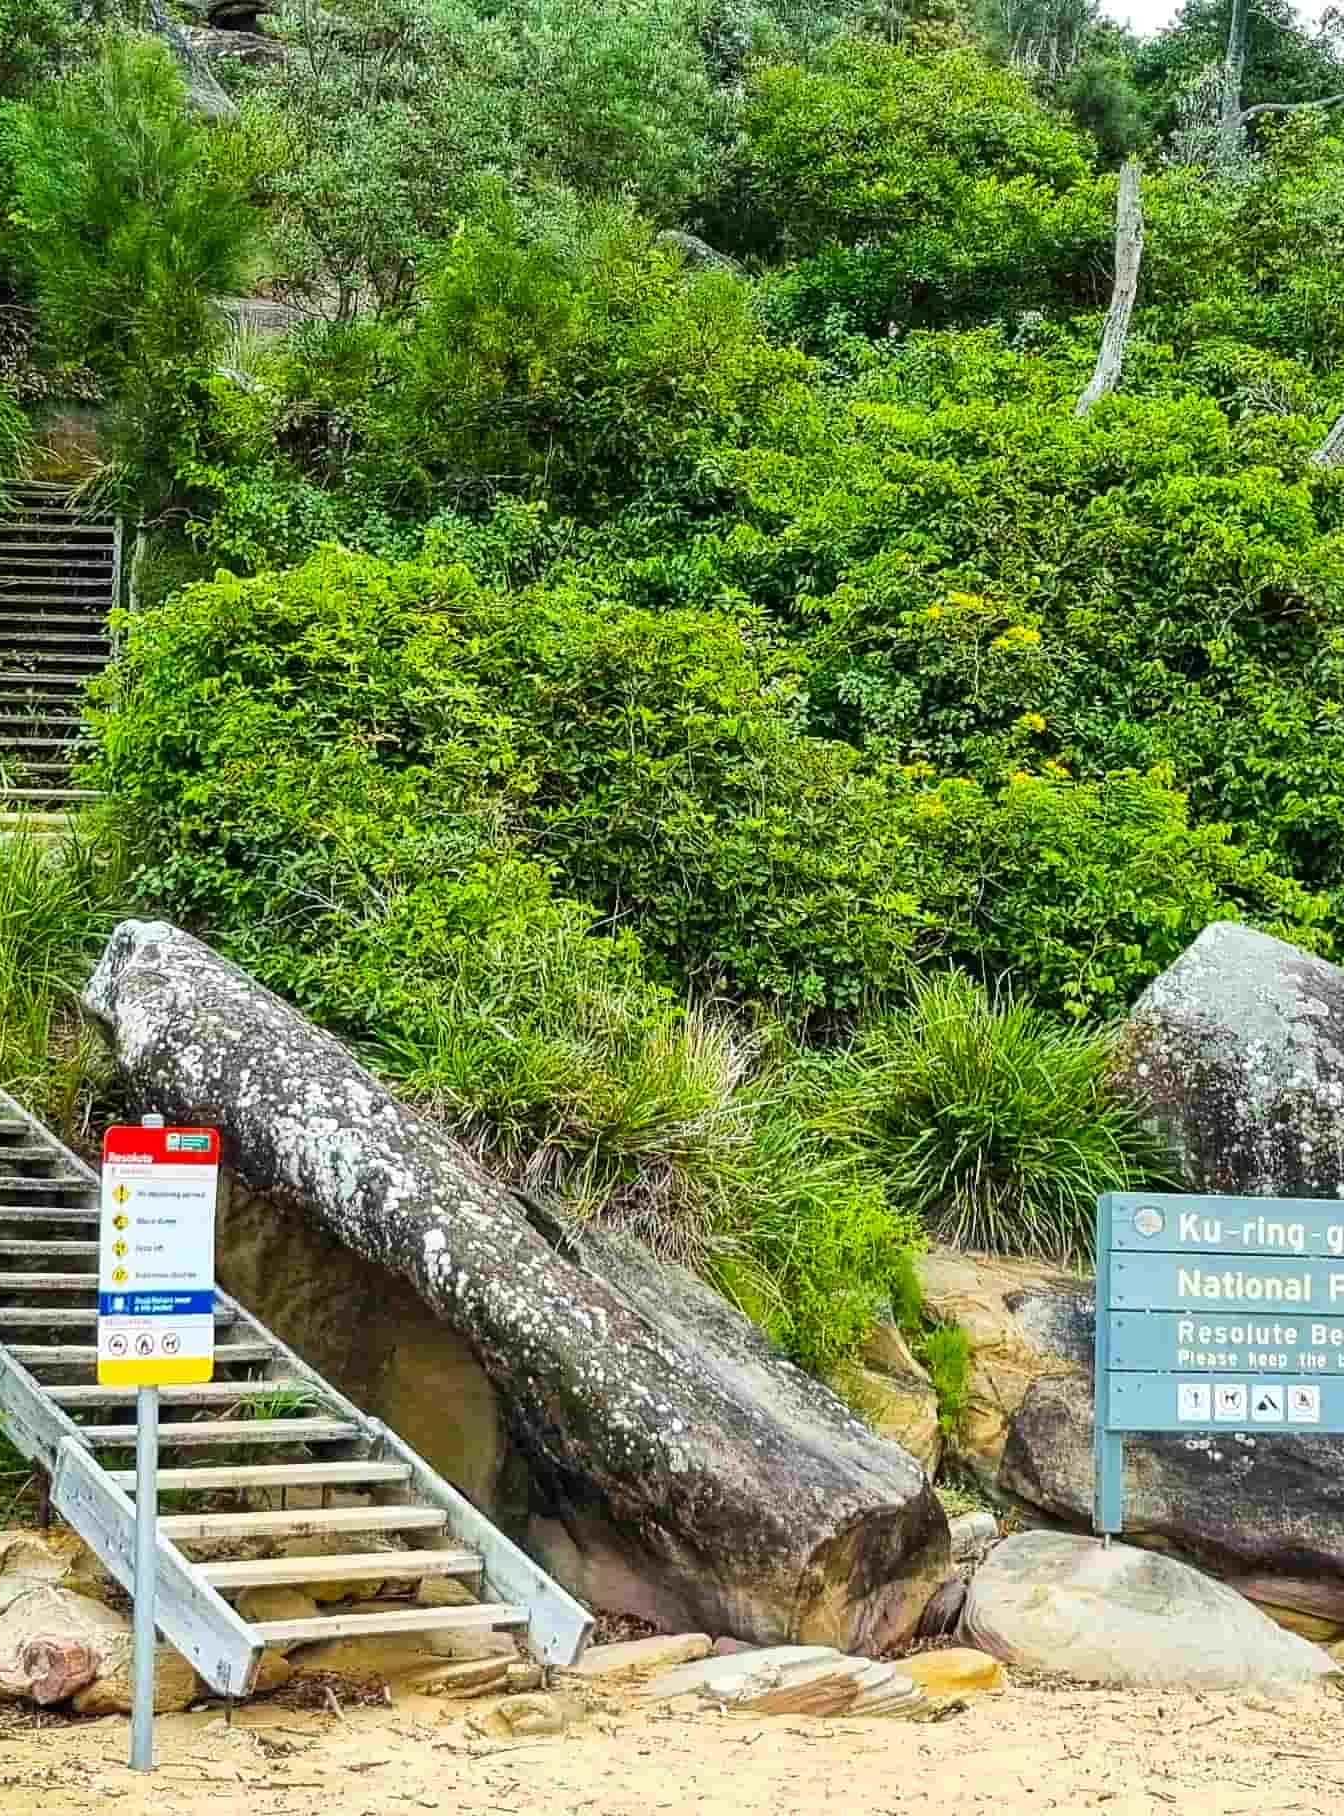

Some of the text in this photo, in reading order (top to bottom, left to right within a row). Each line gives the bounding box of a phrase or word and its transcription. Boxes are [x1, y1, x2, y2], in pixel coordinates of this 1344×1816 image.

[1177, 1268, 1312, 1301] National
[1178, 1320, 1297, 1345] Resolute
[1178, 1350, 1238, 1368] Please
[1248, 1351, 1288, 1369] keep
[1298, 1351, 1326, 1369] the
